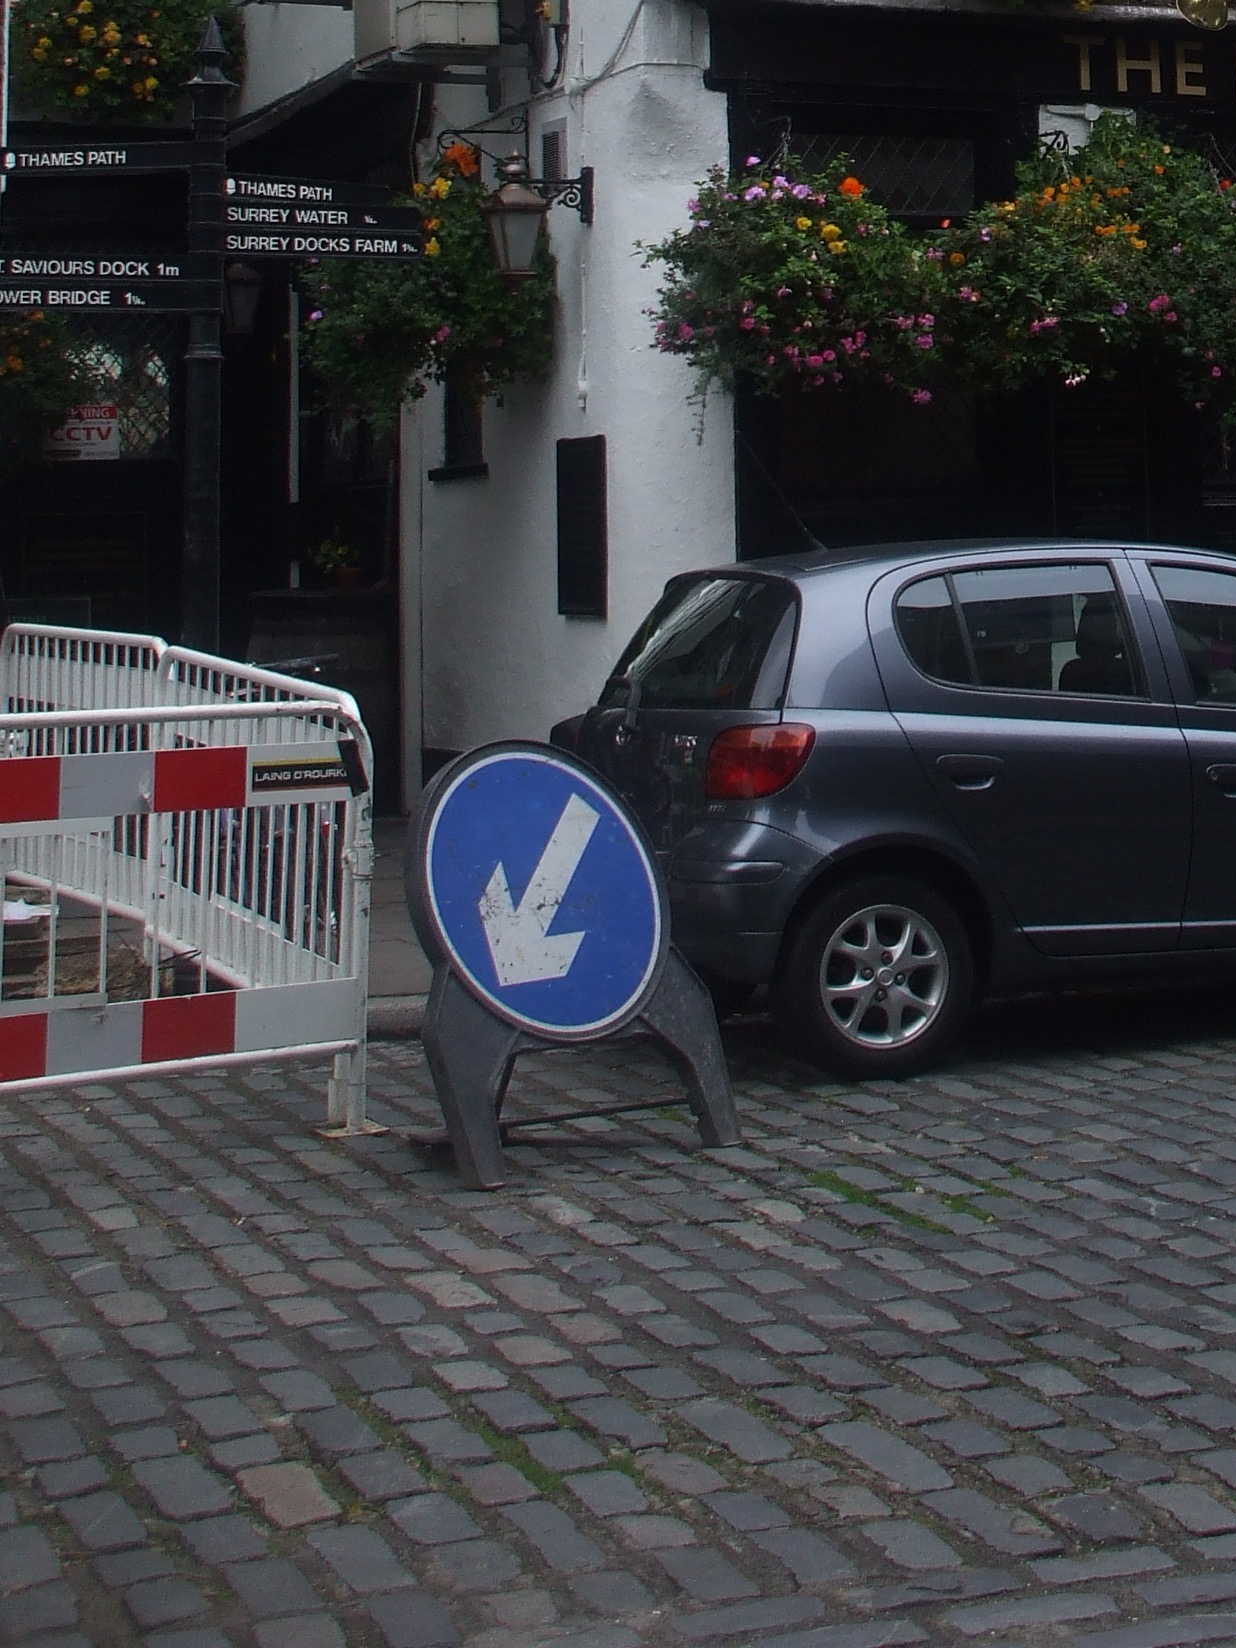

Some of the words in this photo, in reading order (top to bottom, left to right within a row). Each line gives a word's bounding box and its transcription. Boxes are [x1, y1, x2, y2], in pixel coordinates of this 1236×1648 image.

[1063, 34, 1207, 97] THE
[19, 152, 84, 167] THAMES
[88, 150, 126, 165] PATH
[239, 180, 297, 199] THAMES
[299, 185, 333, 201] PATH
[226, 207, 290, 223] SURREY
[295, 210, 349, 225] WATER
[226, 235, 290, 250] SURREY
[294, 238, 350, 252] DOCKS
[355, 239, 398, 253] FARM
[11, 259, 95, 275] SAVIOURS
[99, 261, 150, 276] DOCK
[157, 263, 180, 277] 1m
[0, 290, 42, 305] WER
[48, 290, 111, 305] BRIDGE
[49, 426, 112, 441] CCTV
[255, 770, 292, 783] LAING
